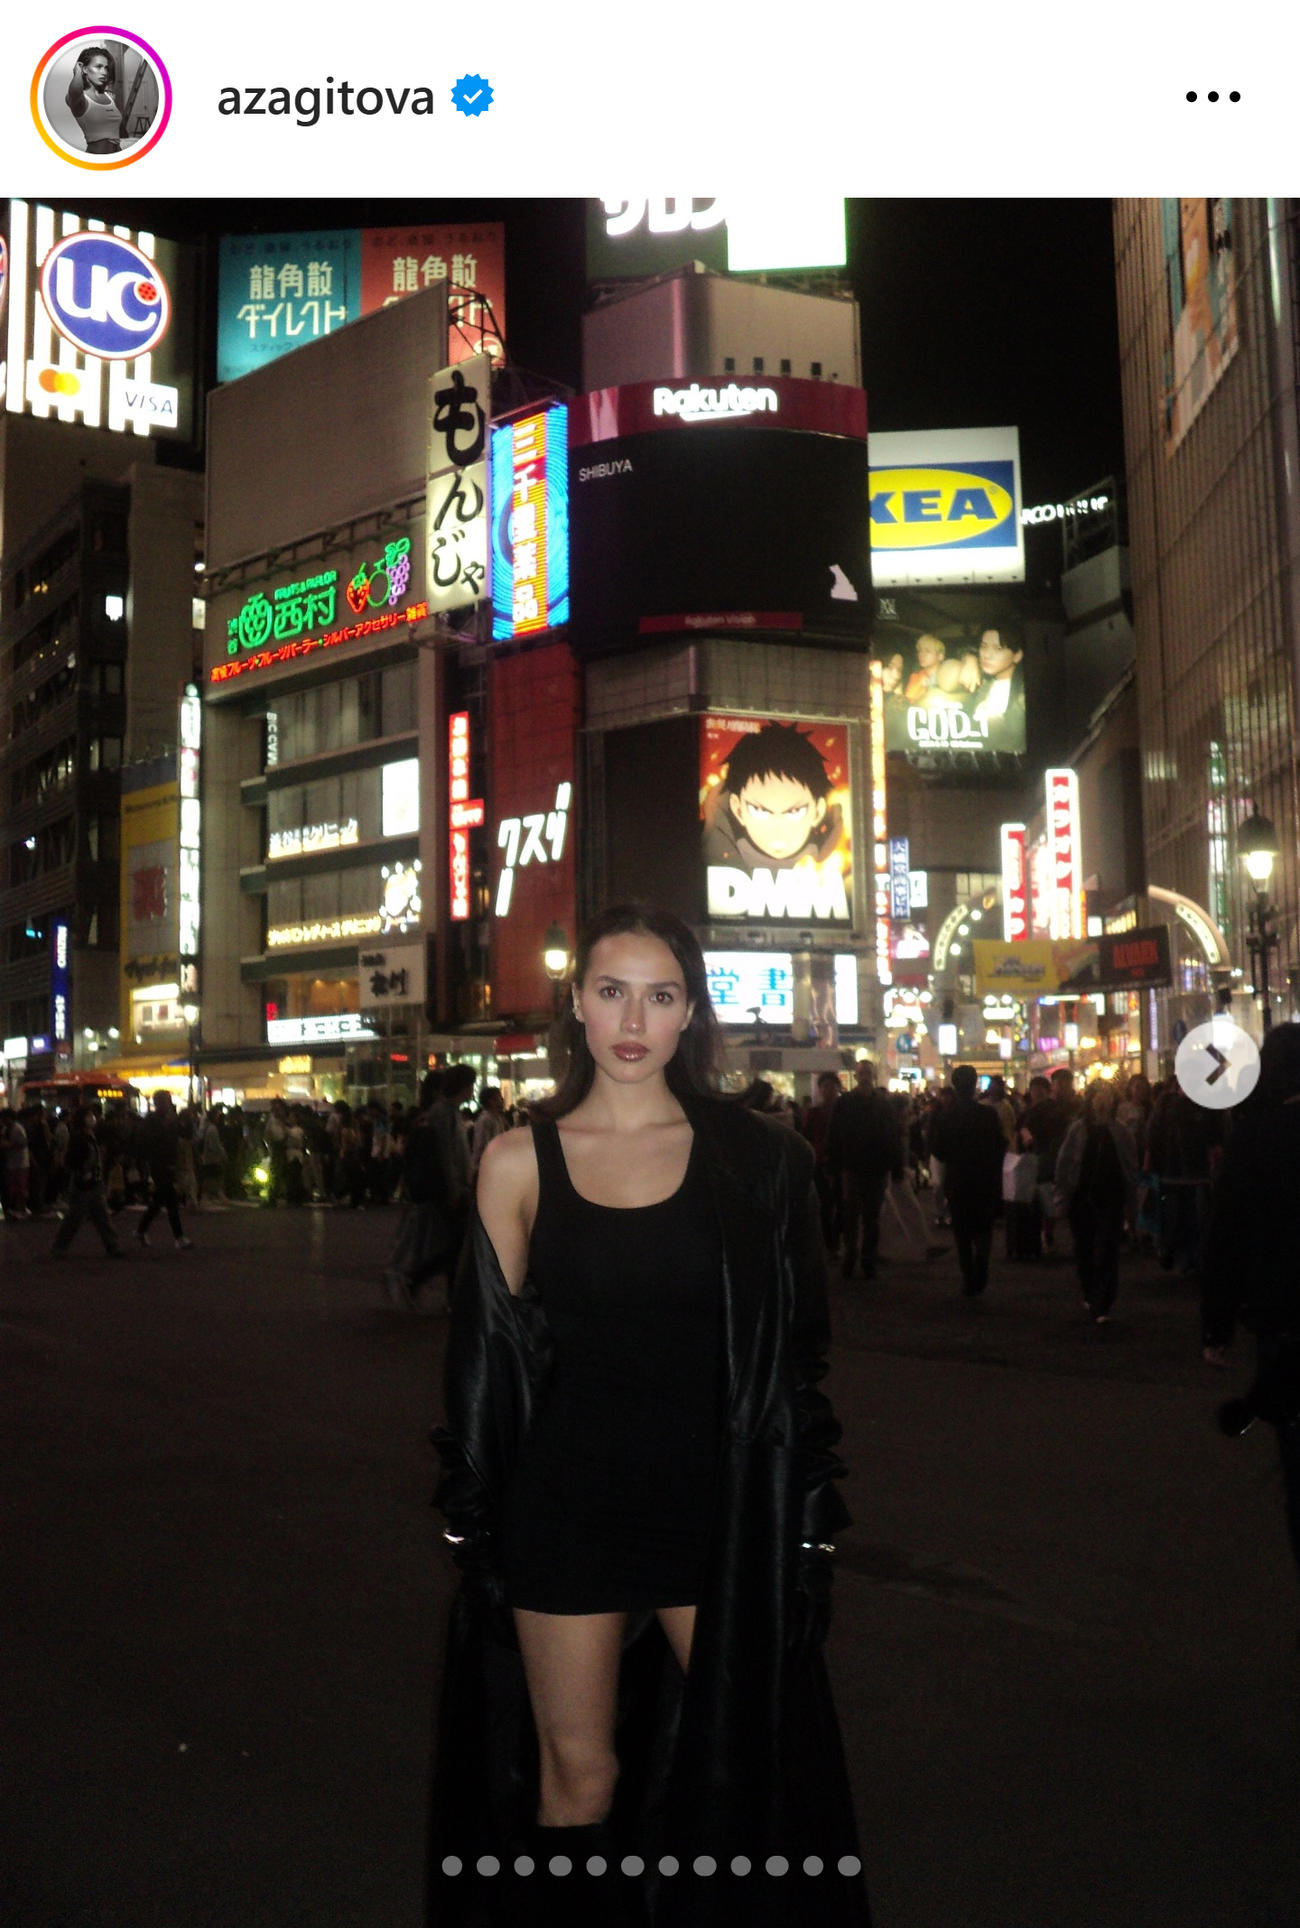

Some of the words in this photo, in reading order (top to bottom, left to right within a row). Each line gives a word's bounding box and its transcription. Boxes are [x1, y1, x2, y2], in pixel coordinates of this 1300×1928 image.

[249, 262, 333, 300] 龍角散
[124, 391, 174, 415] VISA
[653, 383, 778, 418] Rakuten
[432, 369, 486, 595] もんじゃ
[578, 458, 634, 482] SHIBUYA
[274, 587, 336, 640] 西村
[495, 781, 572, 917] クスリ
[706, 865, 849, 919] DMM
